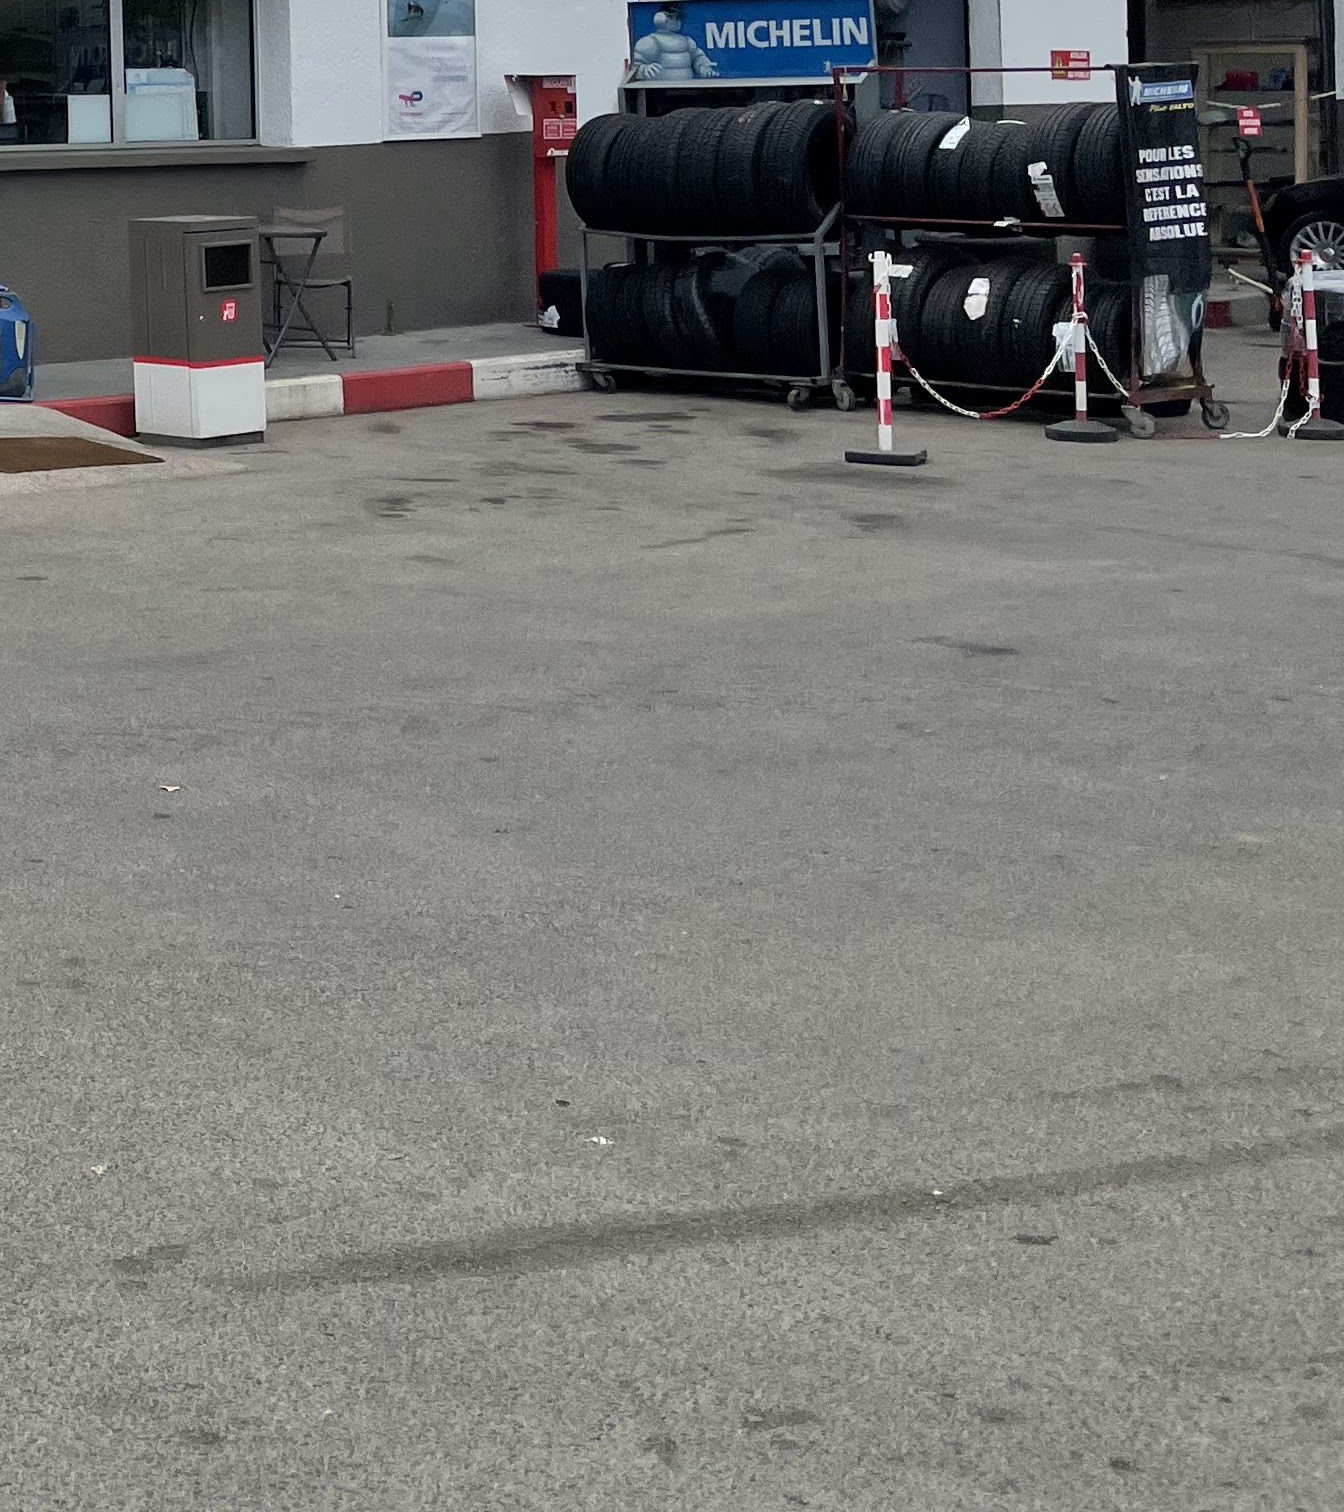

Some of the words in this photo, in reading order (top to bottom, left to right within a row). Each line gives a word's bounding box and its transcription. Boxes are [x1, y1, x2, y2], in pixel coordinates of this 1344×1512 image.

[705, 17, 868, 50] MICHELIN
[1139, 147, 1167, 164] POUR
[1168, 145, 1195, 160] LES
[1136, 164, 1203, 183] SENSATIONS
[1175, 184, 1200, 199] LA
